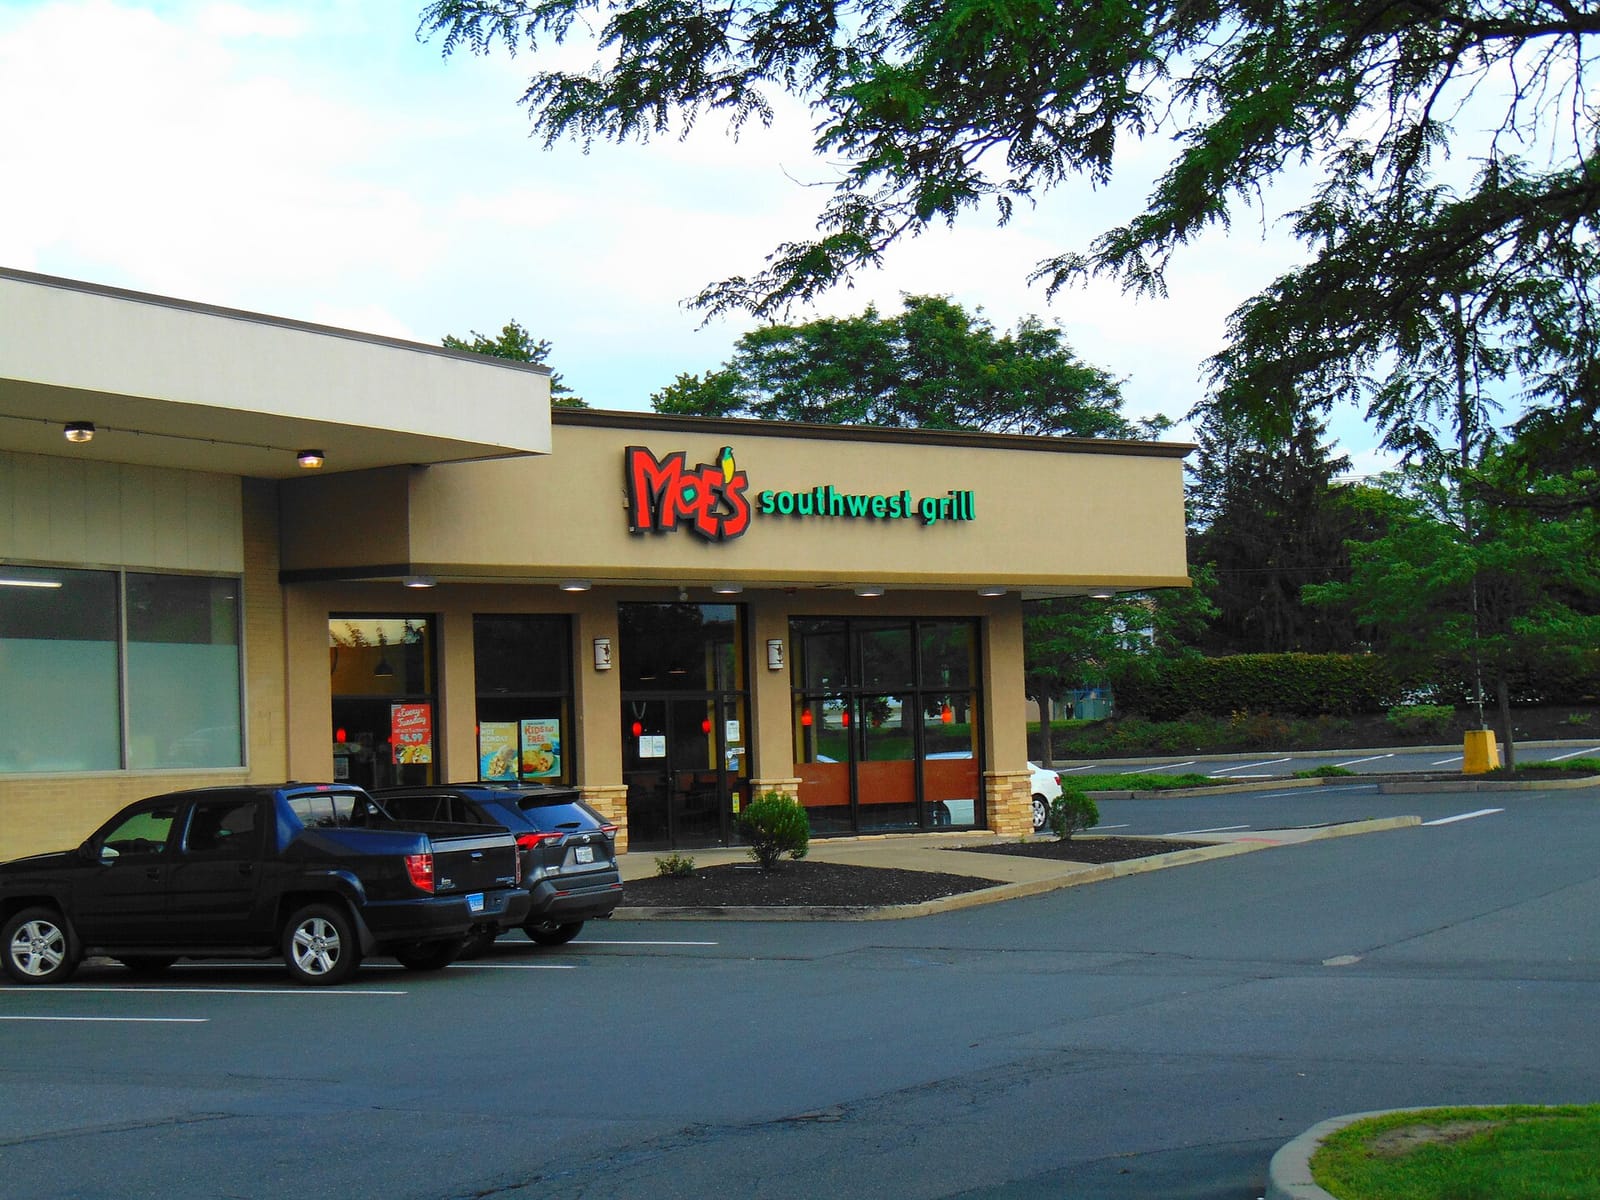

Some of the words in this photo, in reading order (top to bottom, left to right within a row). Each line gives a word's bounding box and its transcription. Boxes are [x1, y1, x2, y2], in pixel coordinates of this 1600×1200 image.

[759, 485, 913, 519] southwest
[920, 490, 976, 526] grill
[397, 717, 426, 727] Tuesday
[525, 725, 545, 736] KIDS
[400, 732, 423, 743] $6.99
[527, 735, 545, 744] FREE
